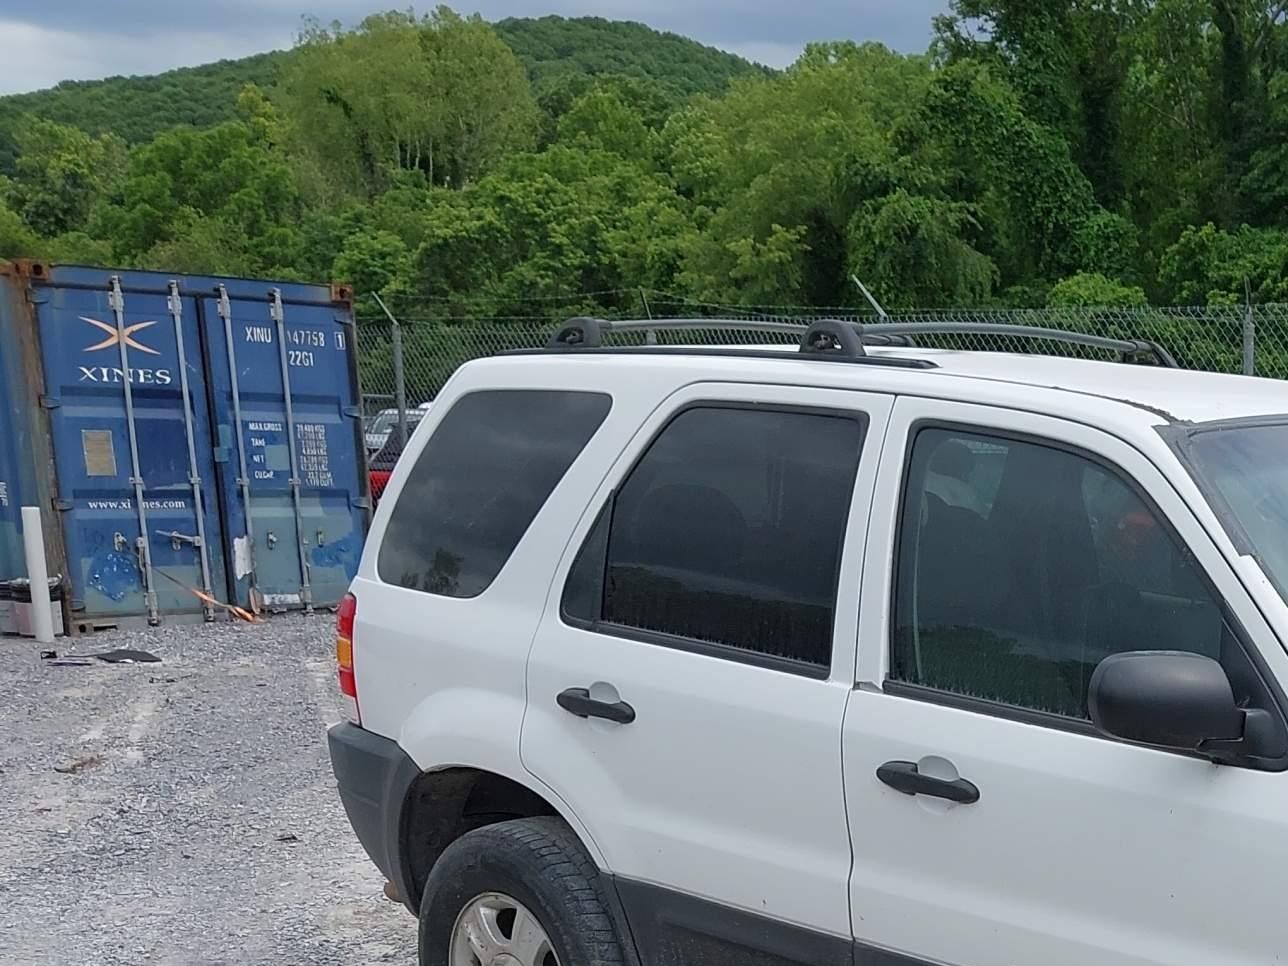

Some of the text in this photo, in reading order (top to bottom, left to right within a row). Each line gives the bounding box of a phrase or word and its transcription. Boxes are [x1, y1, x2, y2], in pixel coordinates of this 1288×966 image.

[245, 327, 272, 343] XINU
[289, 350, 314, 367] 22G1
[78, 366, 172, 385] XINES
